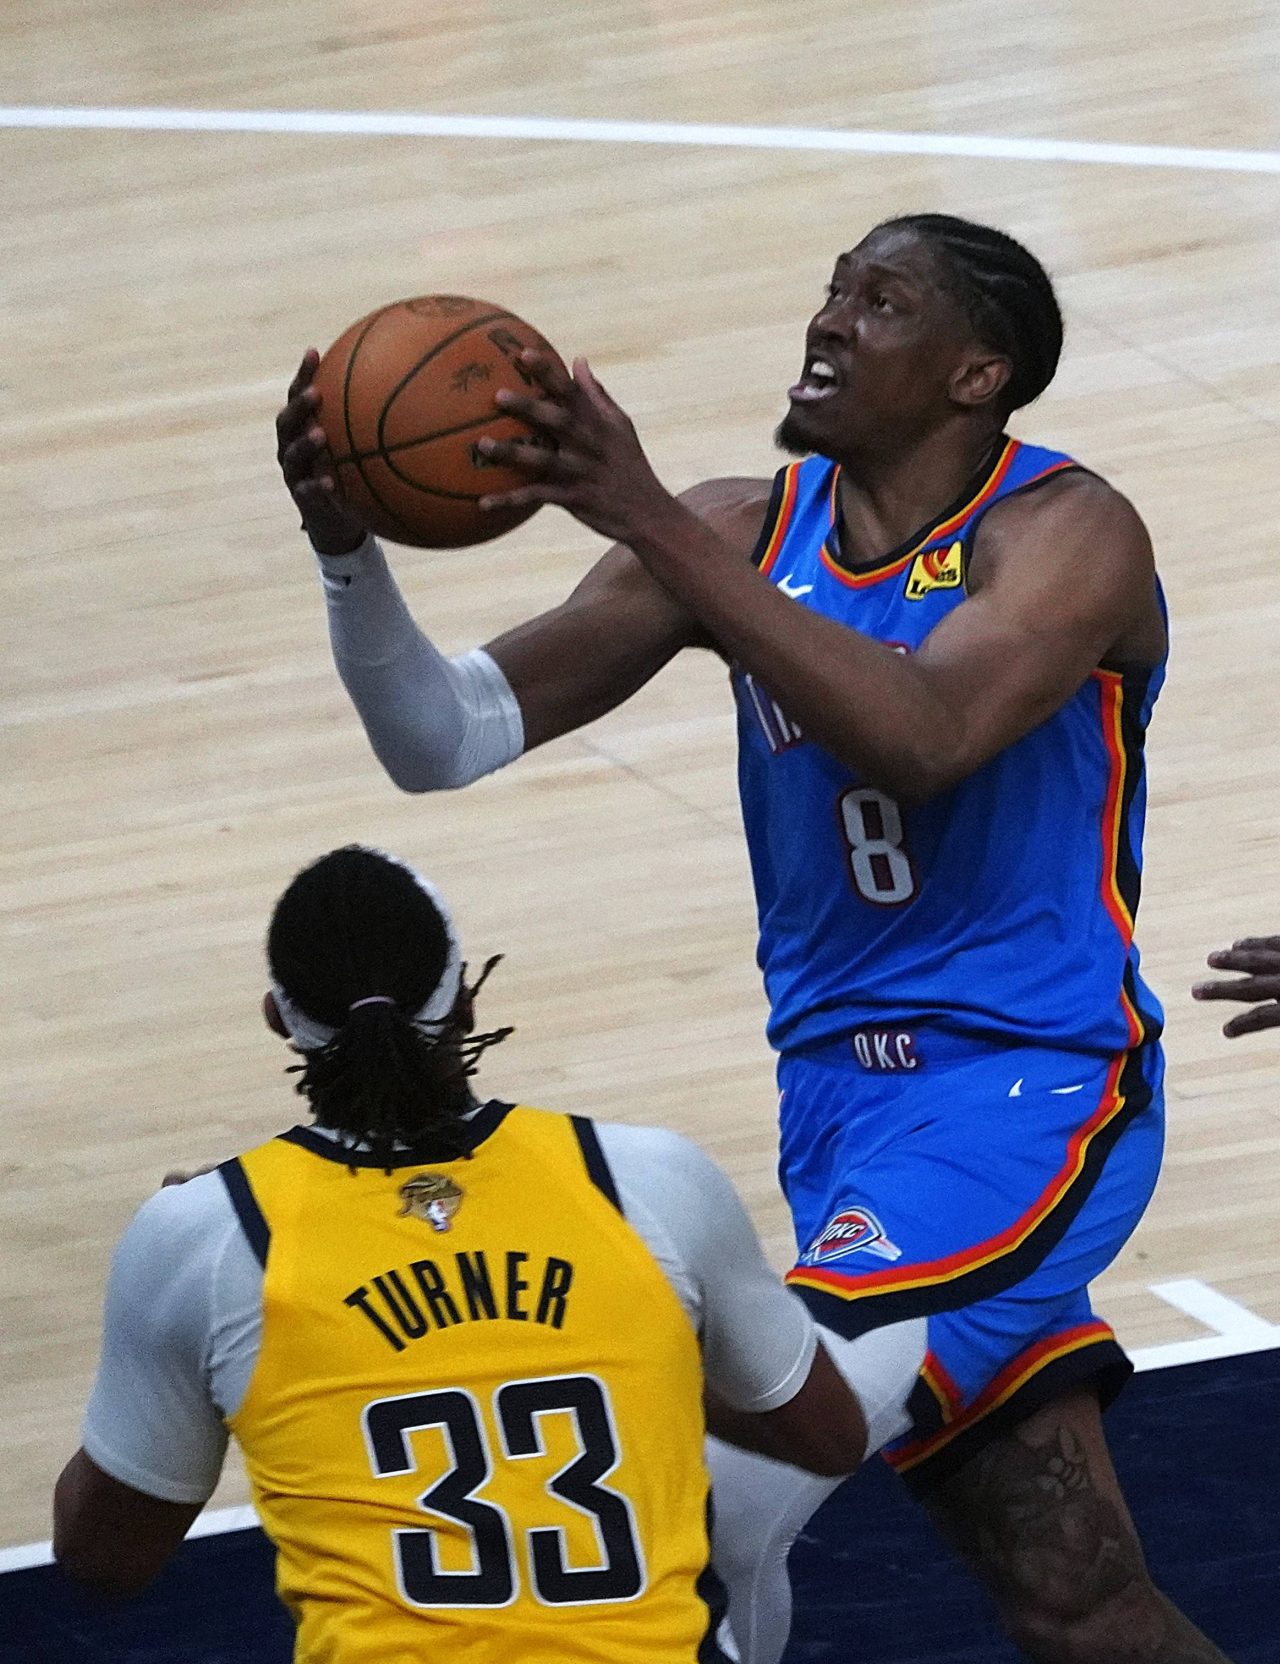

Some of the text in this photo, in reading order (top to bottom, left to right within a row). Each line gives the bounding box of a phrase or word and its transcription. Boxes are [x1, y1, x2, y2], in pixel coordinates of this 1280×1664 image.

[839, 786, 915, 905] 8
[853, 1032, 917, 1069] OKC
[342, 1250, 575, 1353] TURNER
[364, 1373, 647, 1608] 33
